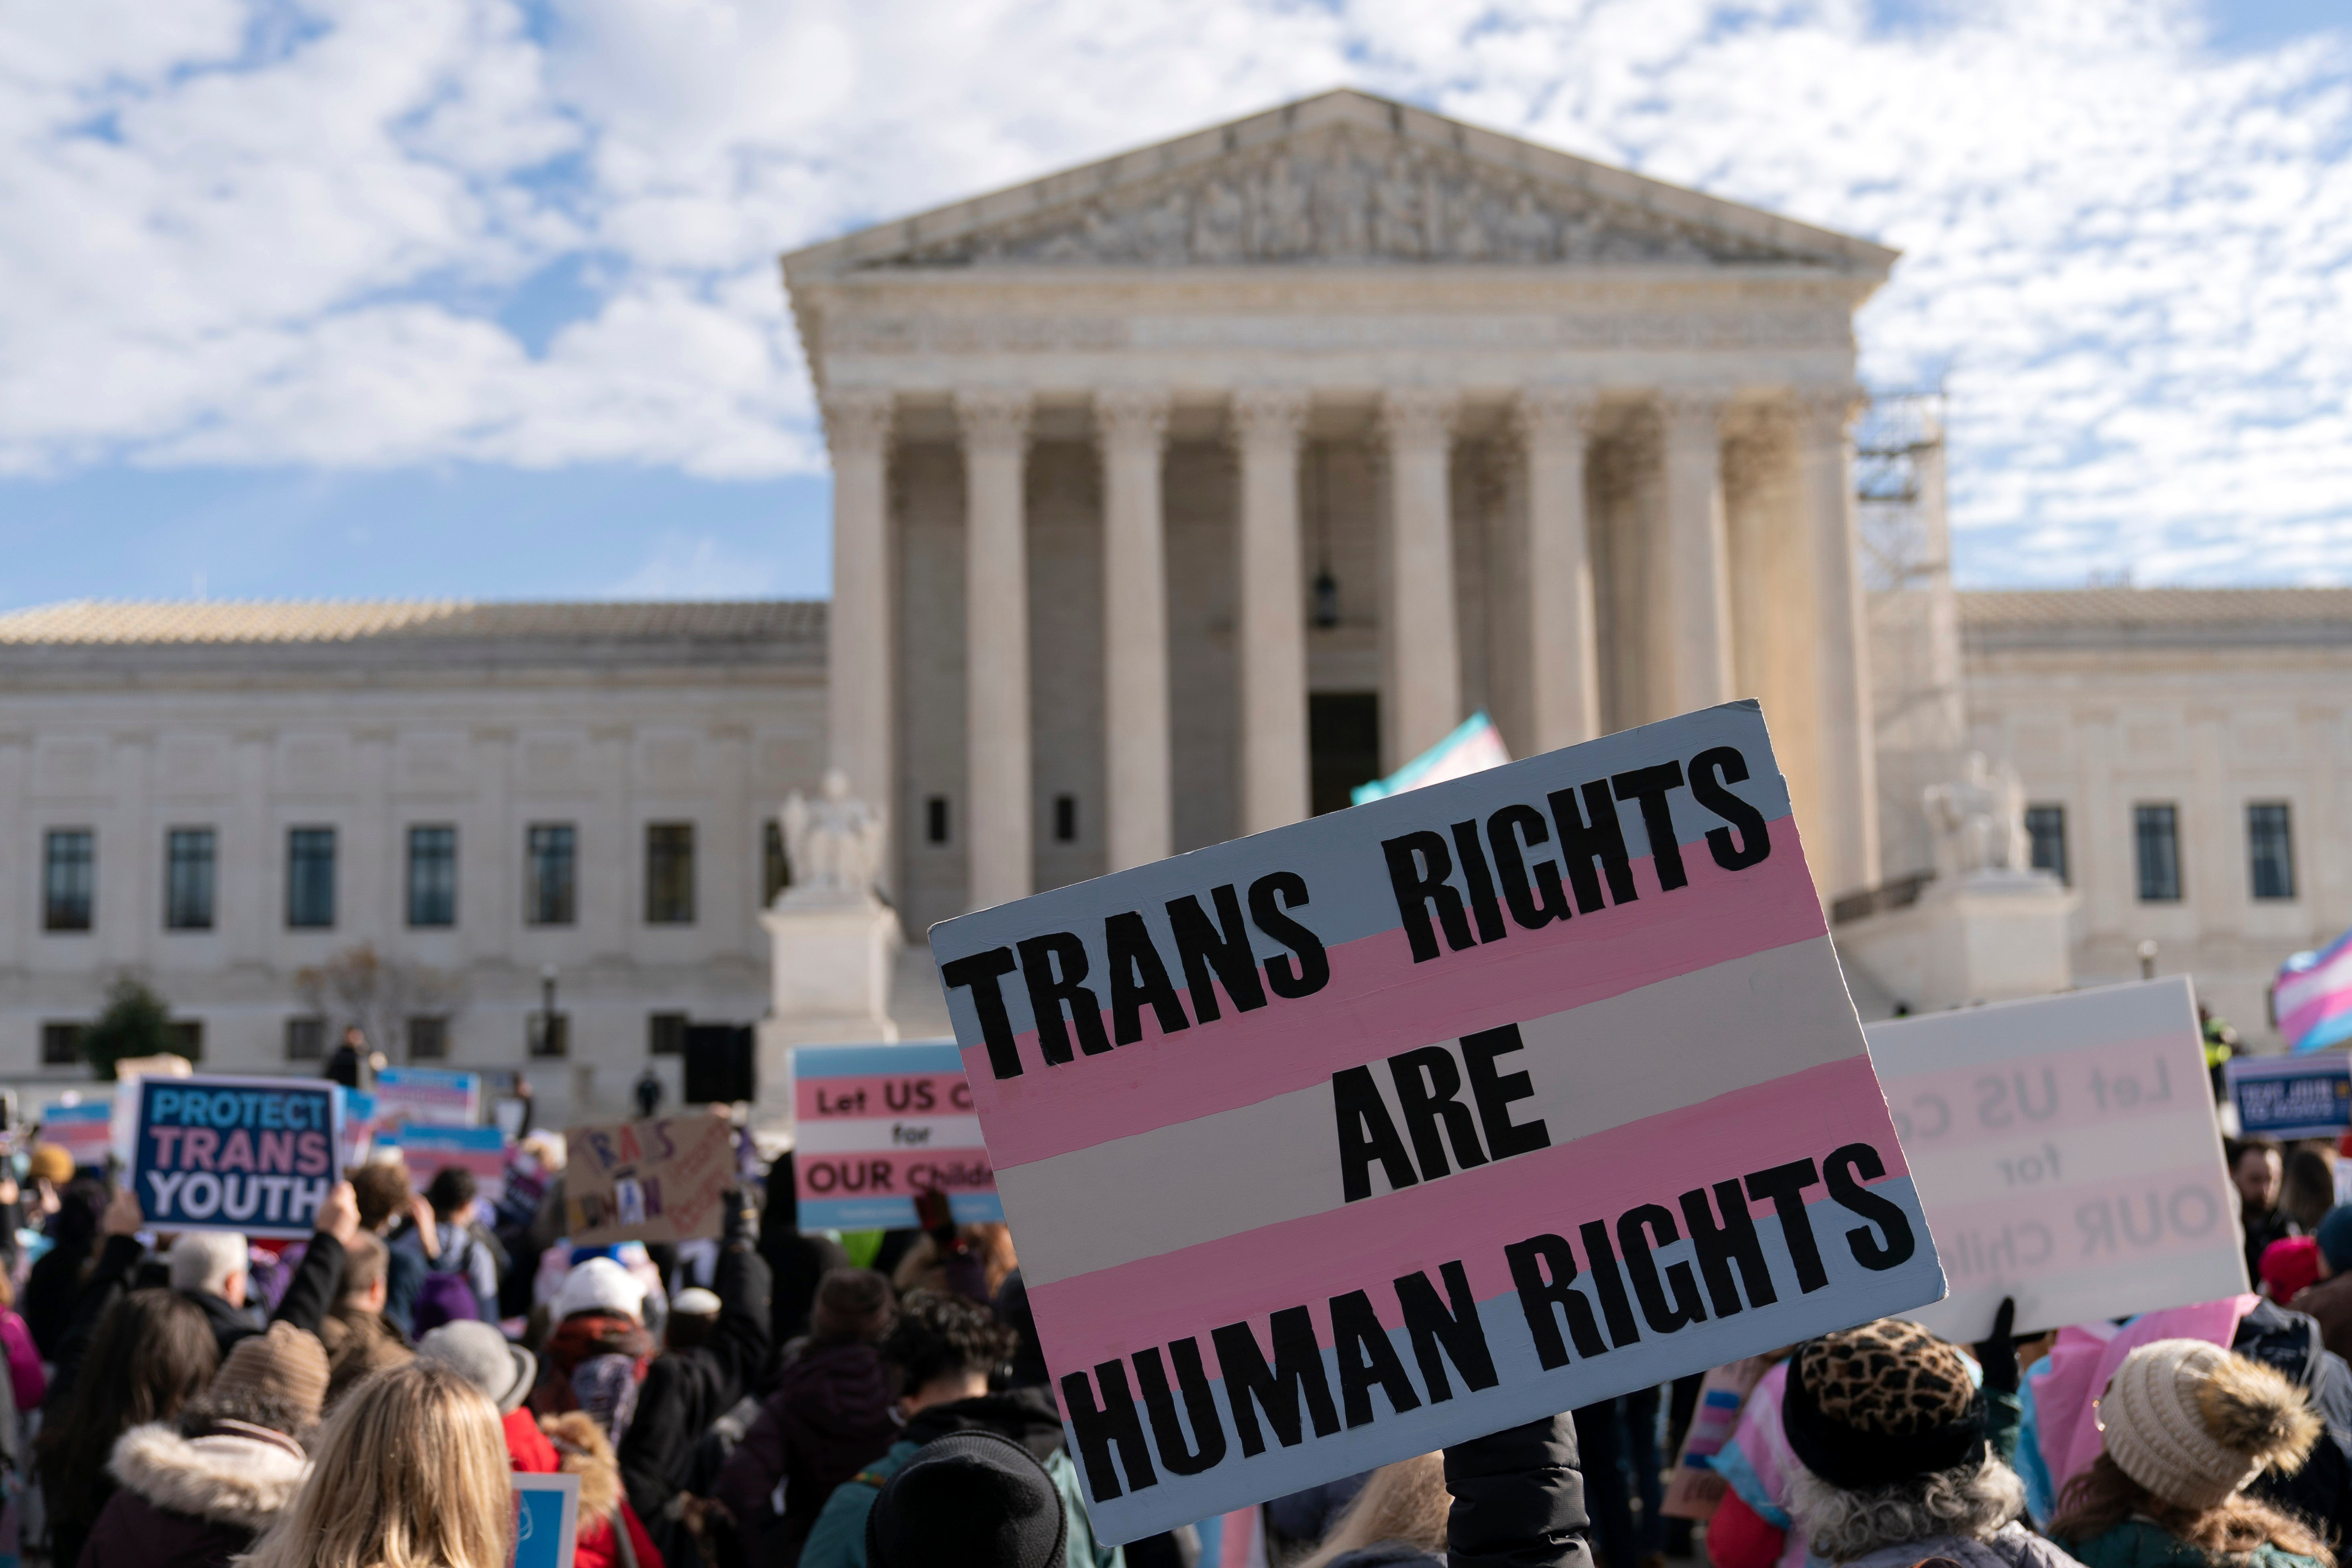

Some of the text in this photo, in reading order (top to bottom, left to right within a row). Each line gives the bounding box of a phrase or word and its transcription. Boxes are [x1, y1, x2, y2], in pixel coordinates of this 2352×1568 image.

[941, 746, 1771, 1080] TRANS RIGHTS
[150, 1089, 325, 1130] PROTECT
[817, 1088, 866, 1114] Let
[885, 1080, 935, 1112] US
[1332, 1022, 1551, 1203] ARE
[149, 1126, 330, 1176] TRANS
[892, 1123, 930, 1145] for
[146, 1169, 330, 1223] YOUTH
[807, 1159, 893, 1193] OUR
[1060, 1143, 1915, 1503] HUMAN RIGHTS
